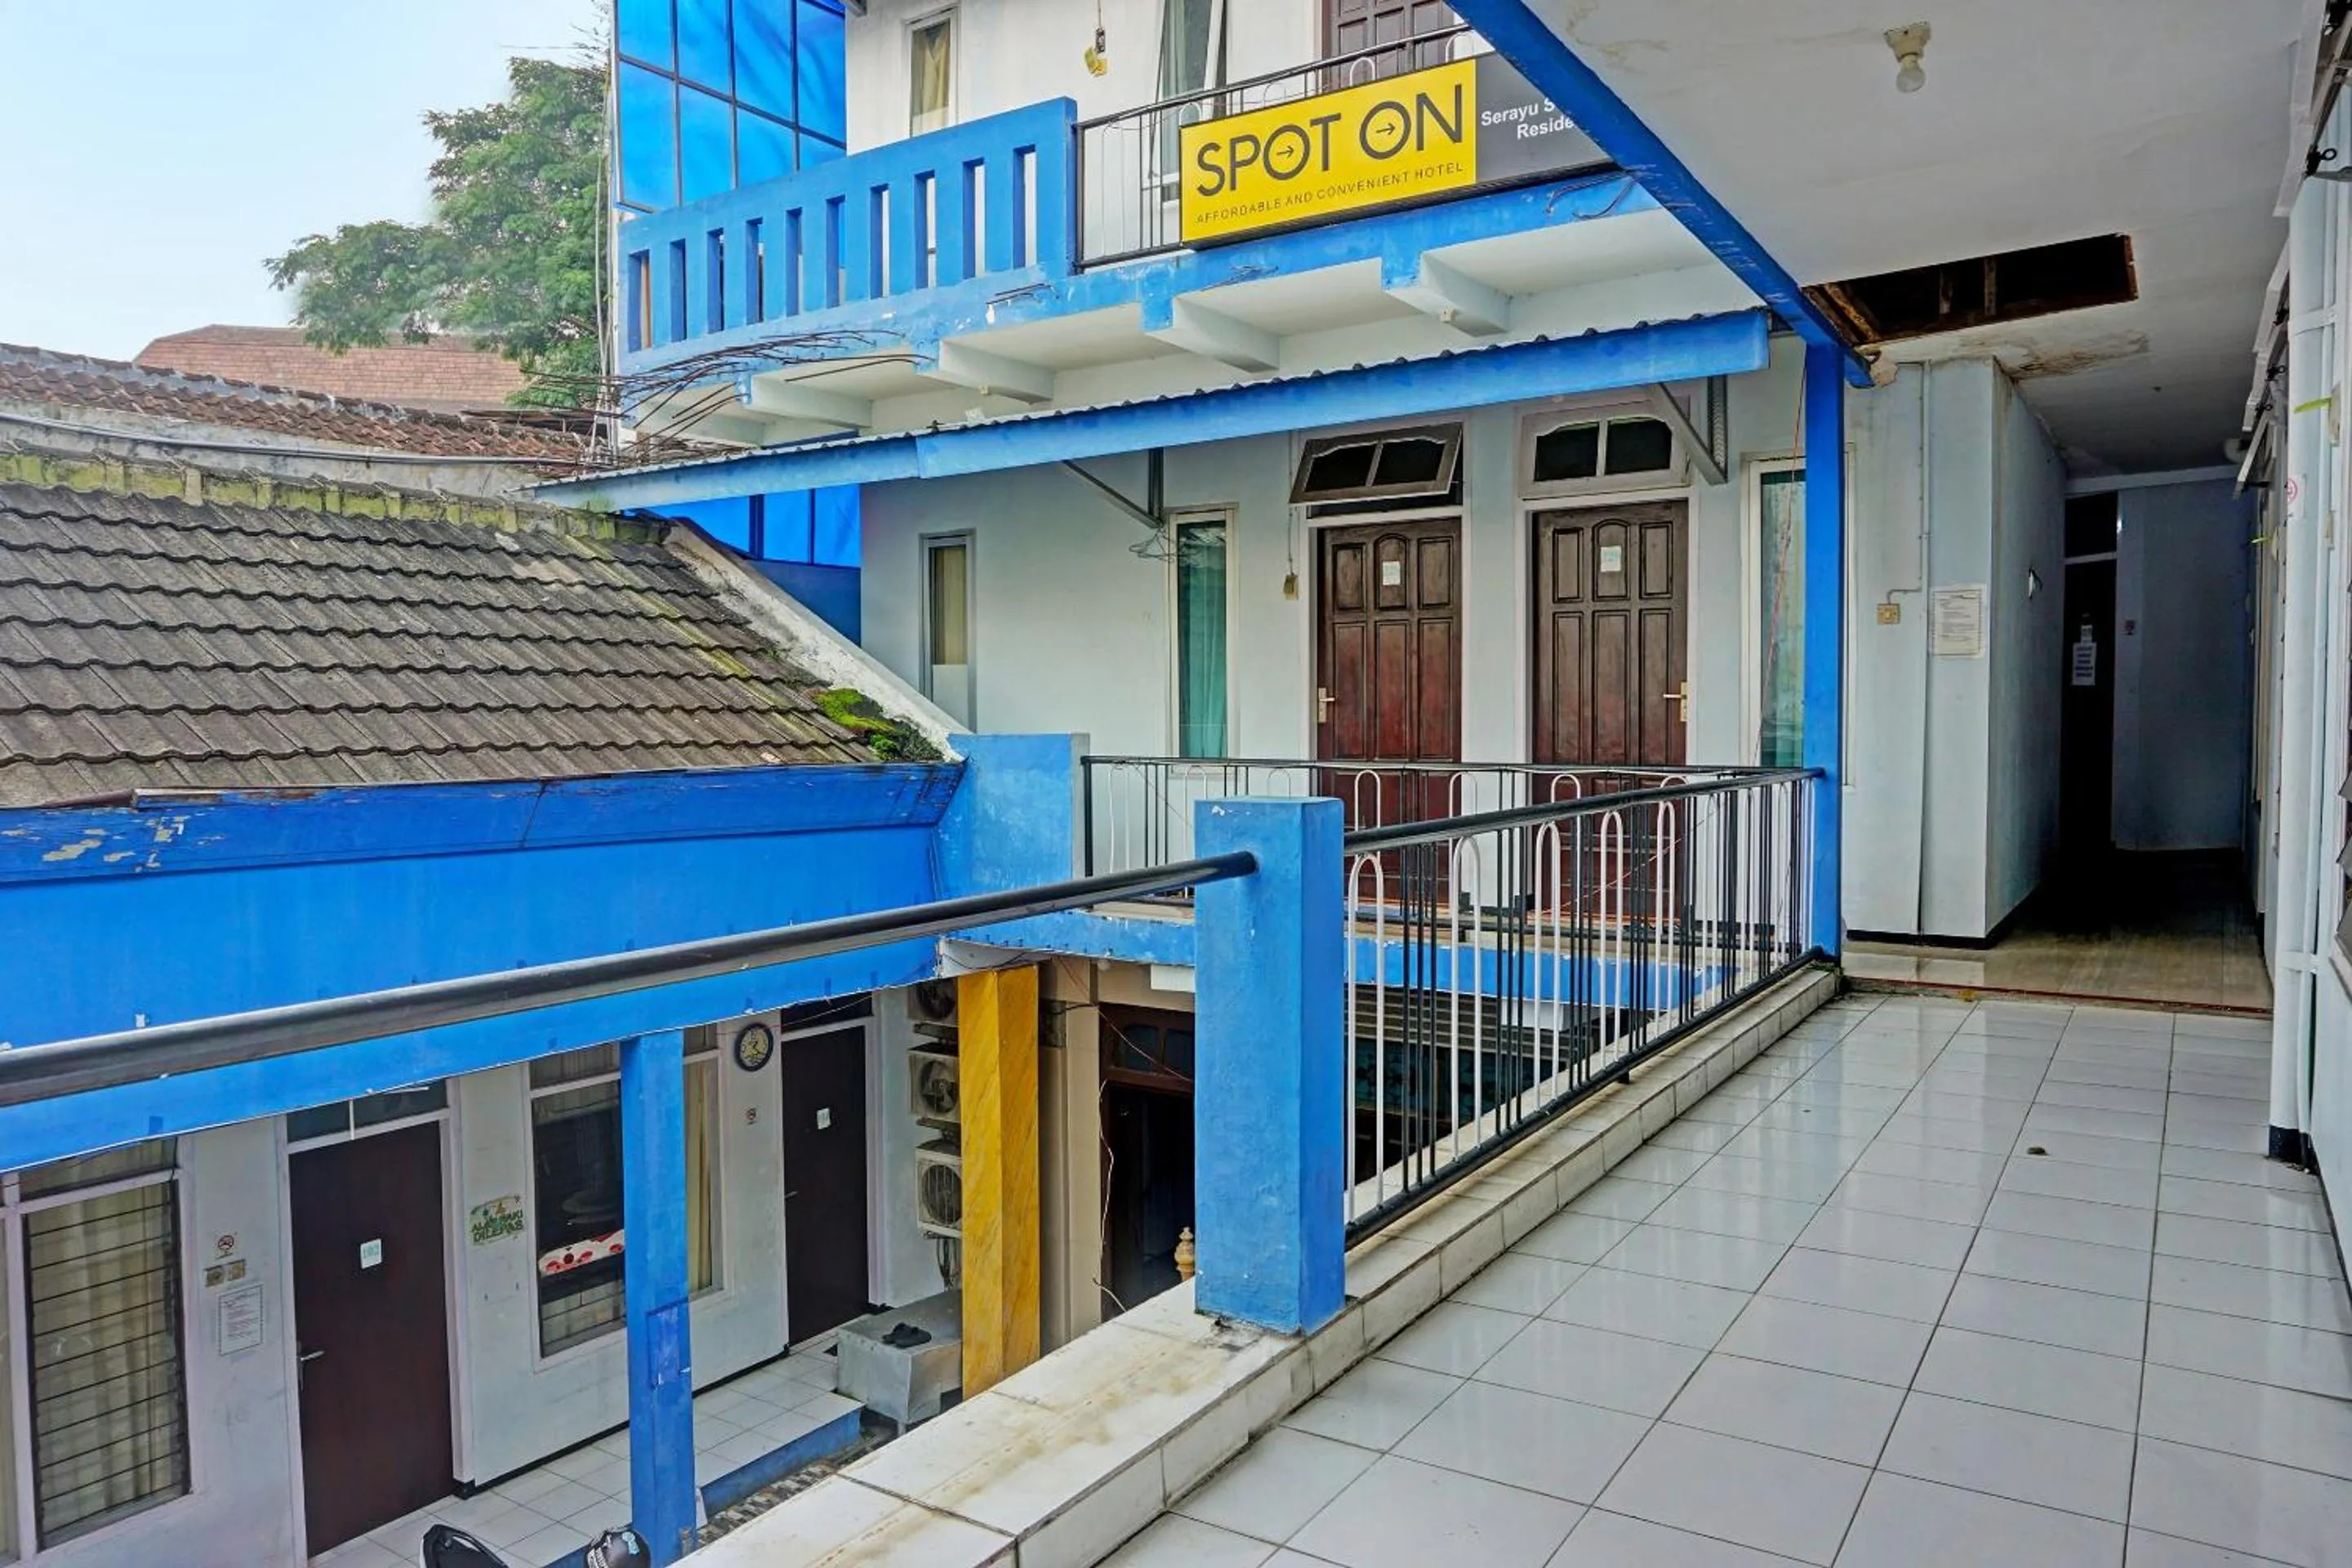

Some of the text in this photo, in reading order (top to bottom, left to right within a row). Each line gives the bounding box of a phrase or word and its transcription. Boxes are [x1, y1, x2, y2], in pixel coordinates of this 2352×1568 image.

[1196, 82, 1463, 197] SPOT ON
[1481, 102, 1539, 127] Serayu
[1196, 163, 1463, 224] AFFORDABLE AND CONVENIENT HOTEL
